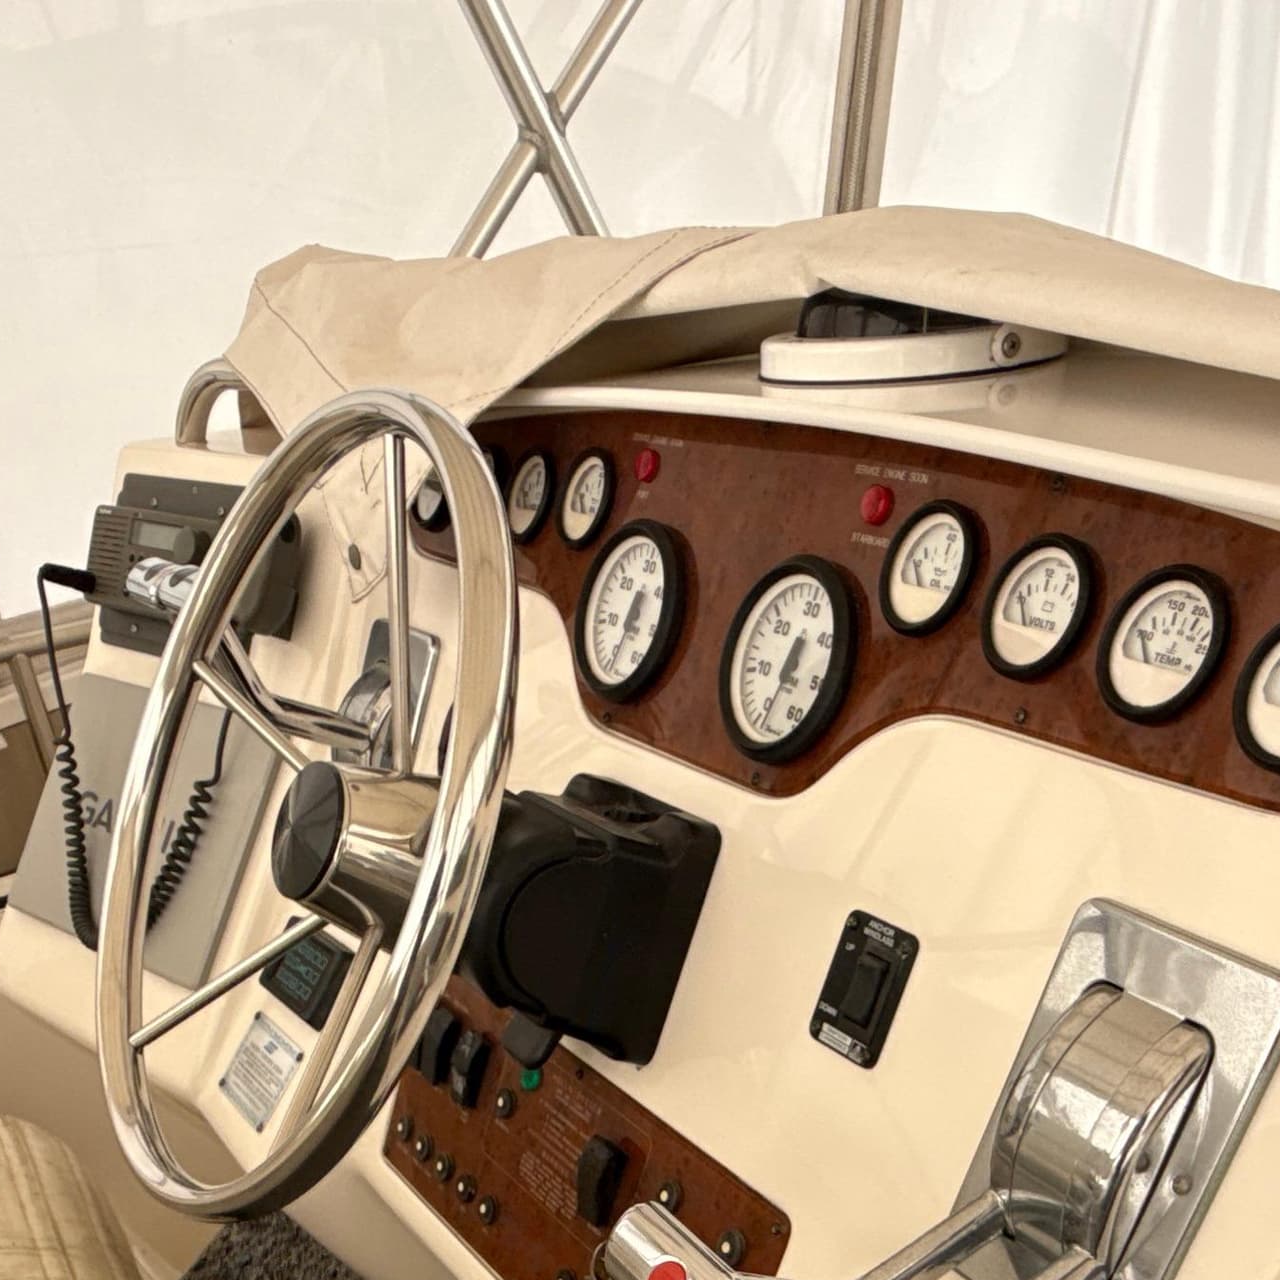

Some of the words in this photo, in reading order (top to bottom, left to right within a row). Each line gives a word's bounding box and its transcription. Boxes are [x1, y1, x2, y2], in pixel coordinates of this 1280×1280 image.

[642, 559, 657, 574] 30
[620, 575, 634, 591] 20
[803, 601, 821, 618] 30
[1167, 599, 1186, 612] 150
[607, 613, 619, 627] 10
[773, 619, 791, 636] 20
[1029, 616, 1056, 631] VOLTS
[817, 631, 833, 649] 40
[1154, 652, 1182, 666] TEMP
[758, 659, 772, 677] 10
[786, 705, 804, 723] 60
